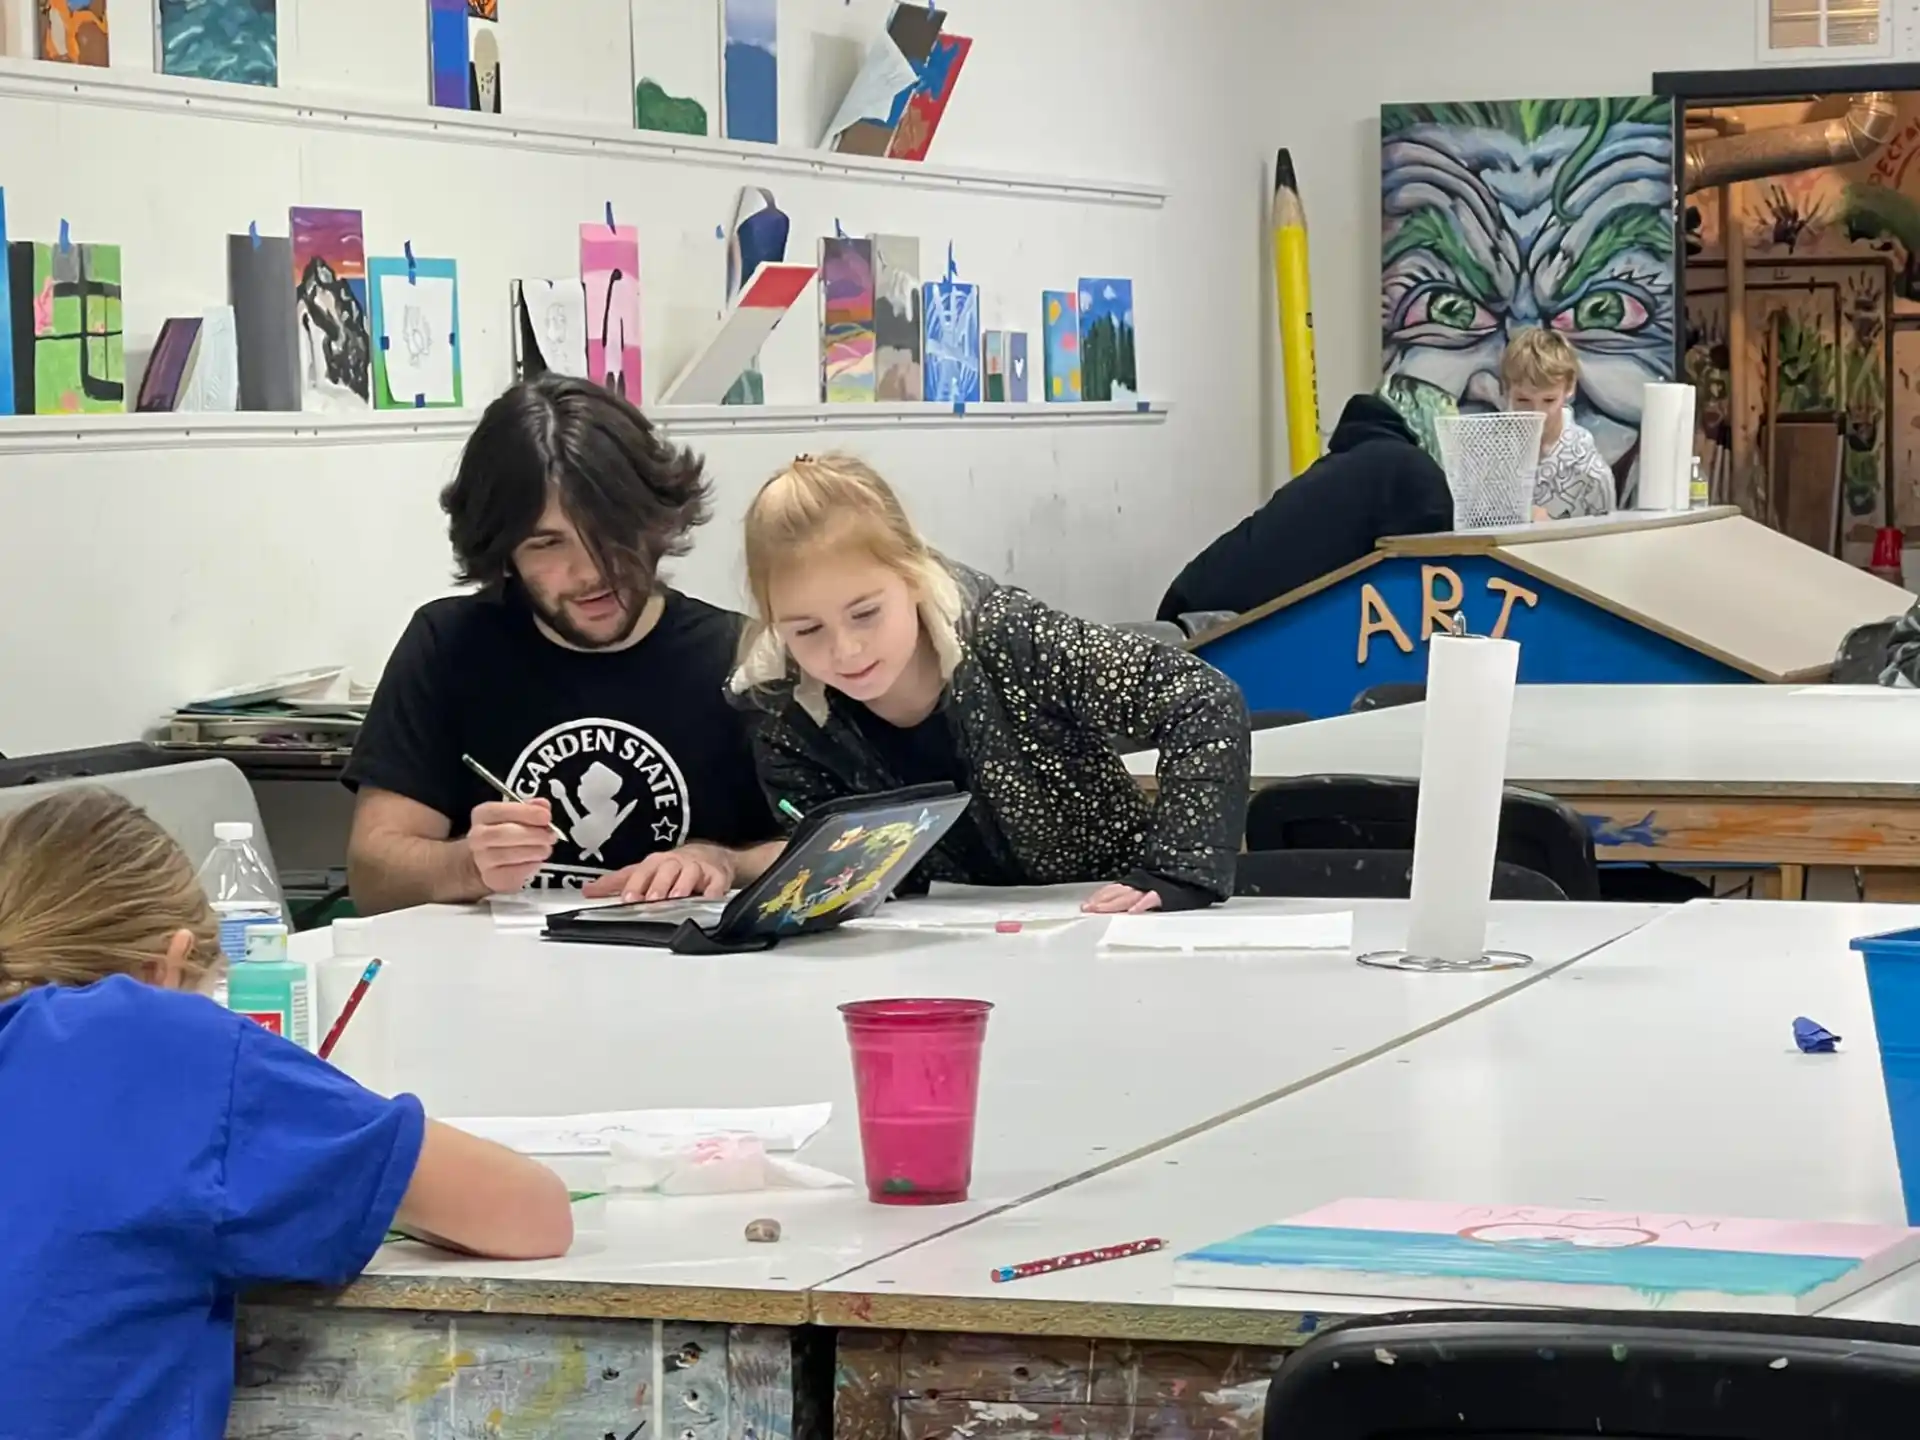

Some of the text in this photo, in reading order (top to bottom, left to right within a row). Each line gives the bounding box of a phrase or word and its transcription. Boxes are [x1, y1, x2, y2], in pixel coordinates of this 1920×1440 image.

[1357, 565, 1538, 663] ART
[516, 728, 678, 810] GARDEN STATE
